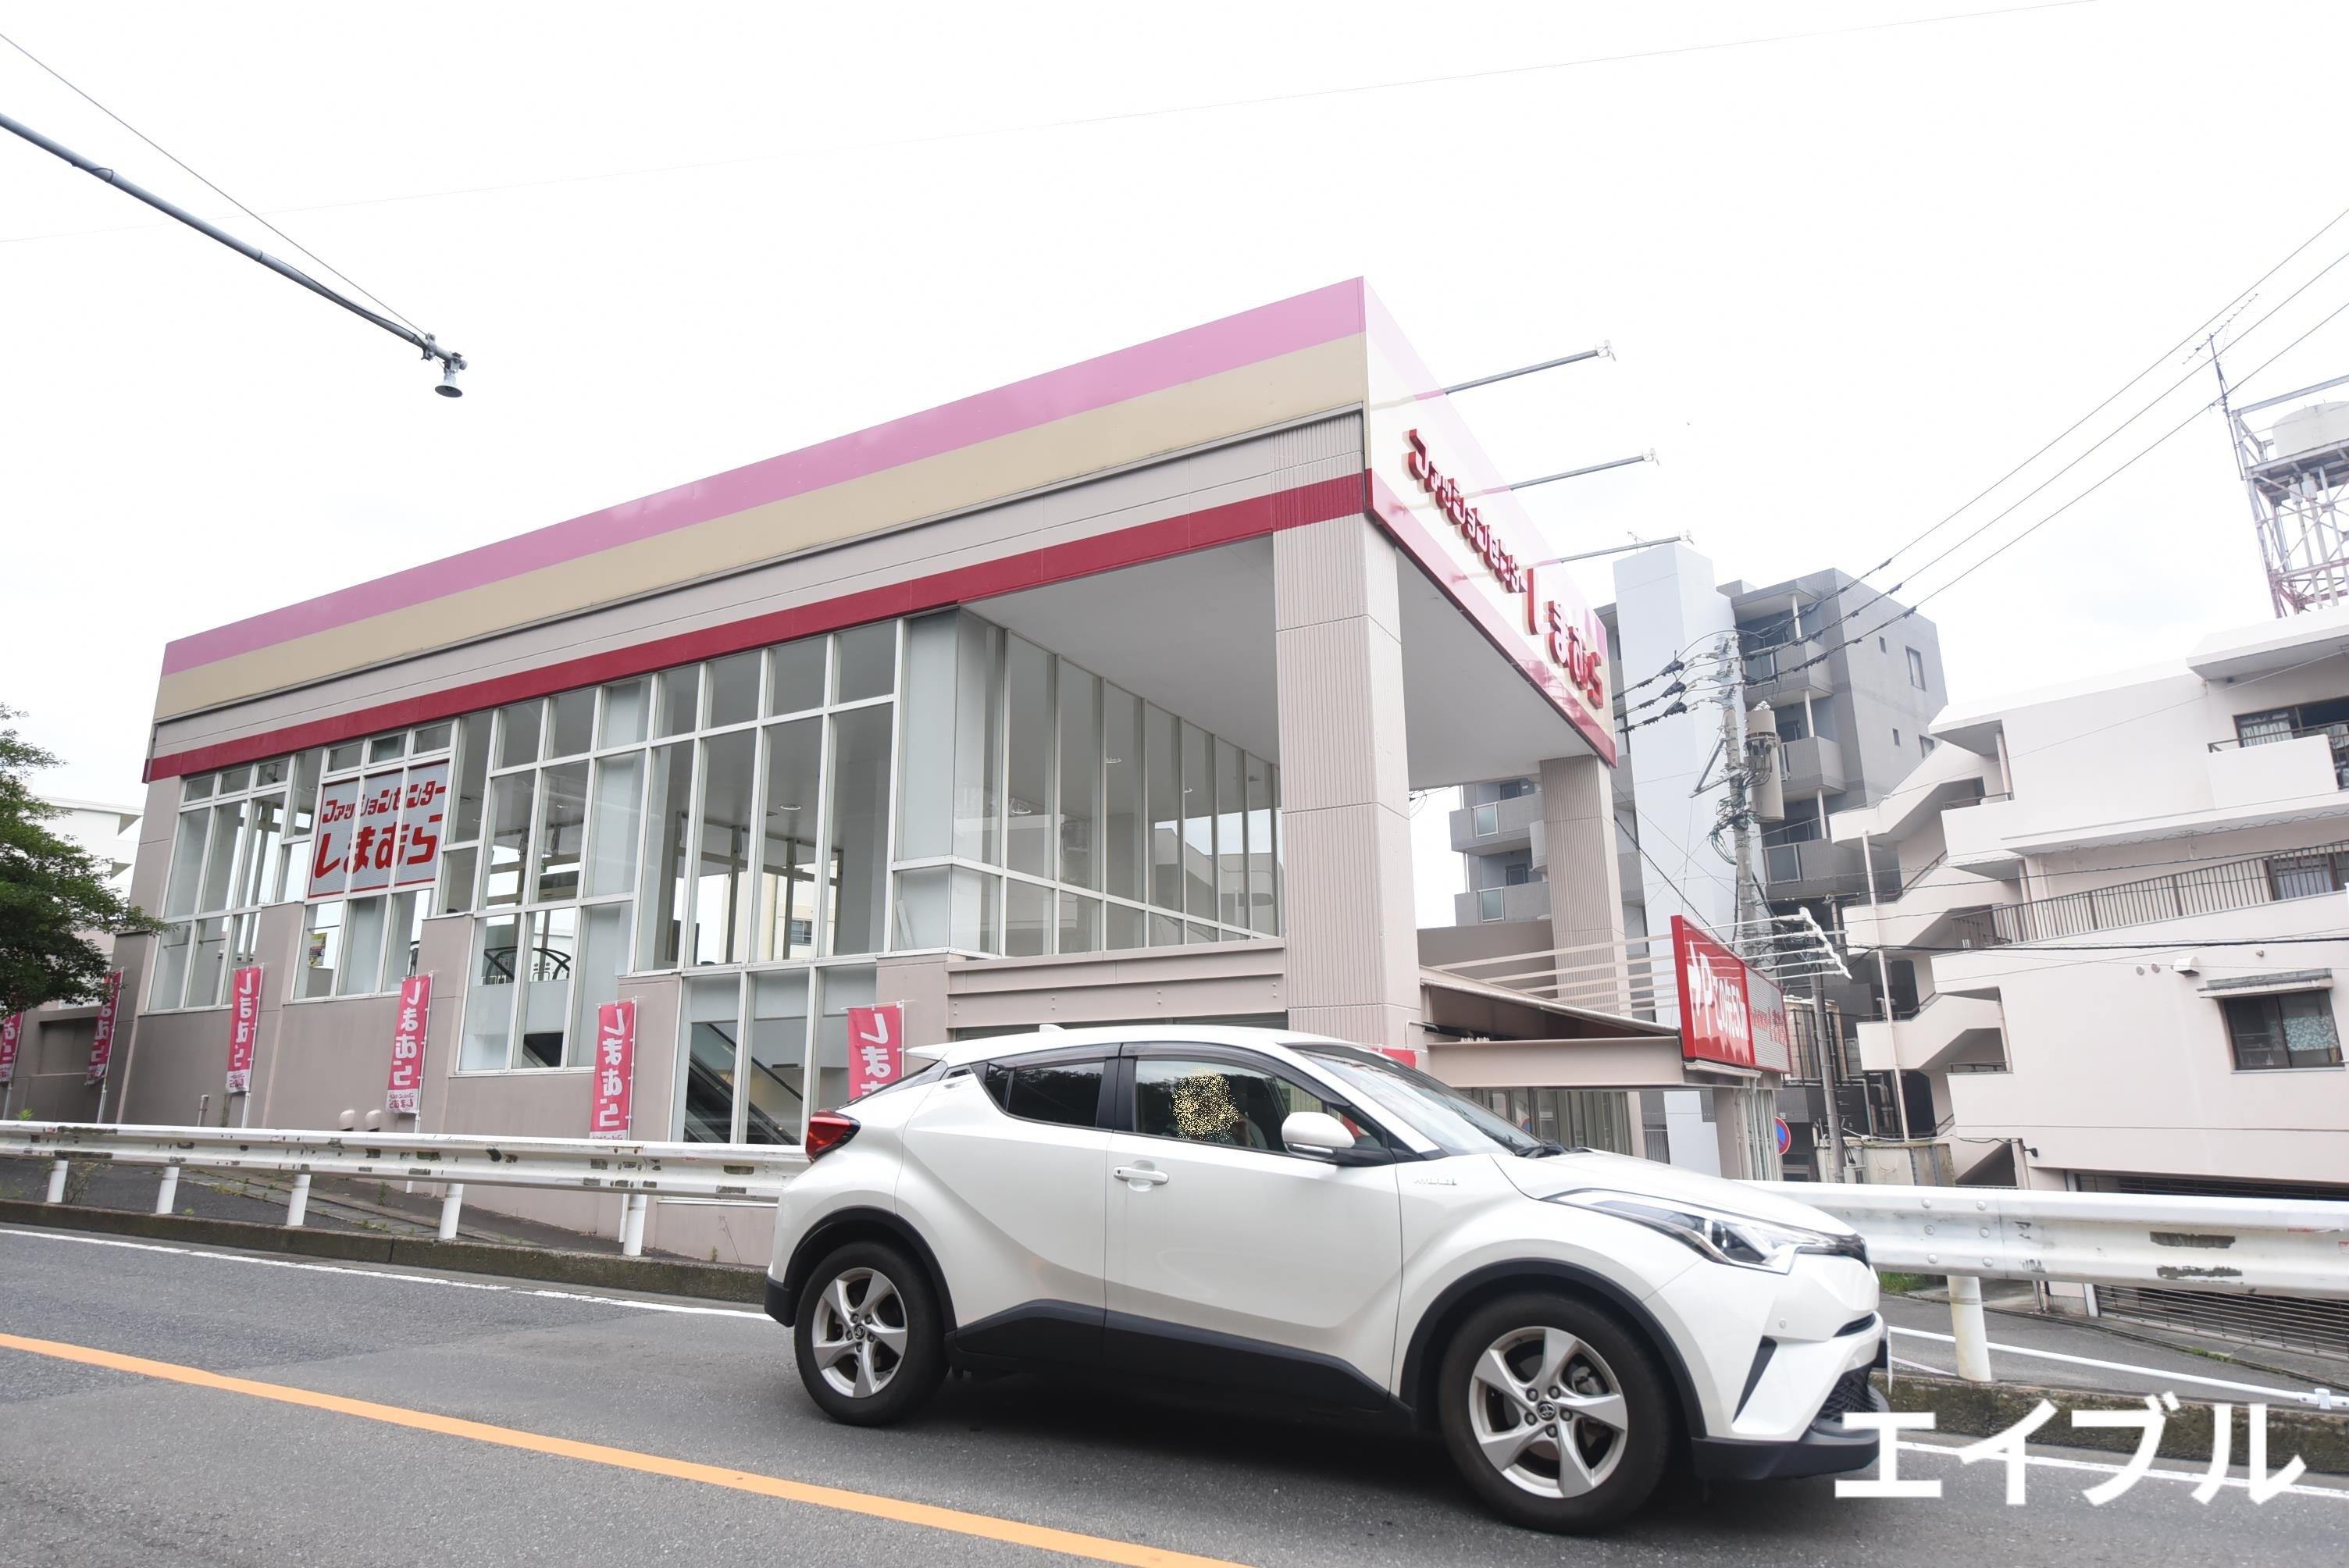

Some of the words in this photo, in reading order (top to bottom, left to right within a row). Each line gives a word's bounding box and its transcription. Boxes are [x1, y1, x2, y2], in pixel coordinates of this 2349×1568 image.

[1527, 568, 1603, 710] しまむら
[314, 814, 444, 878] しまむら
